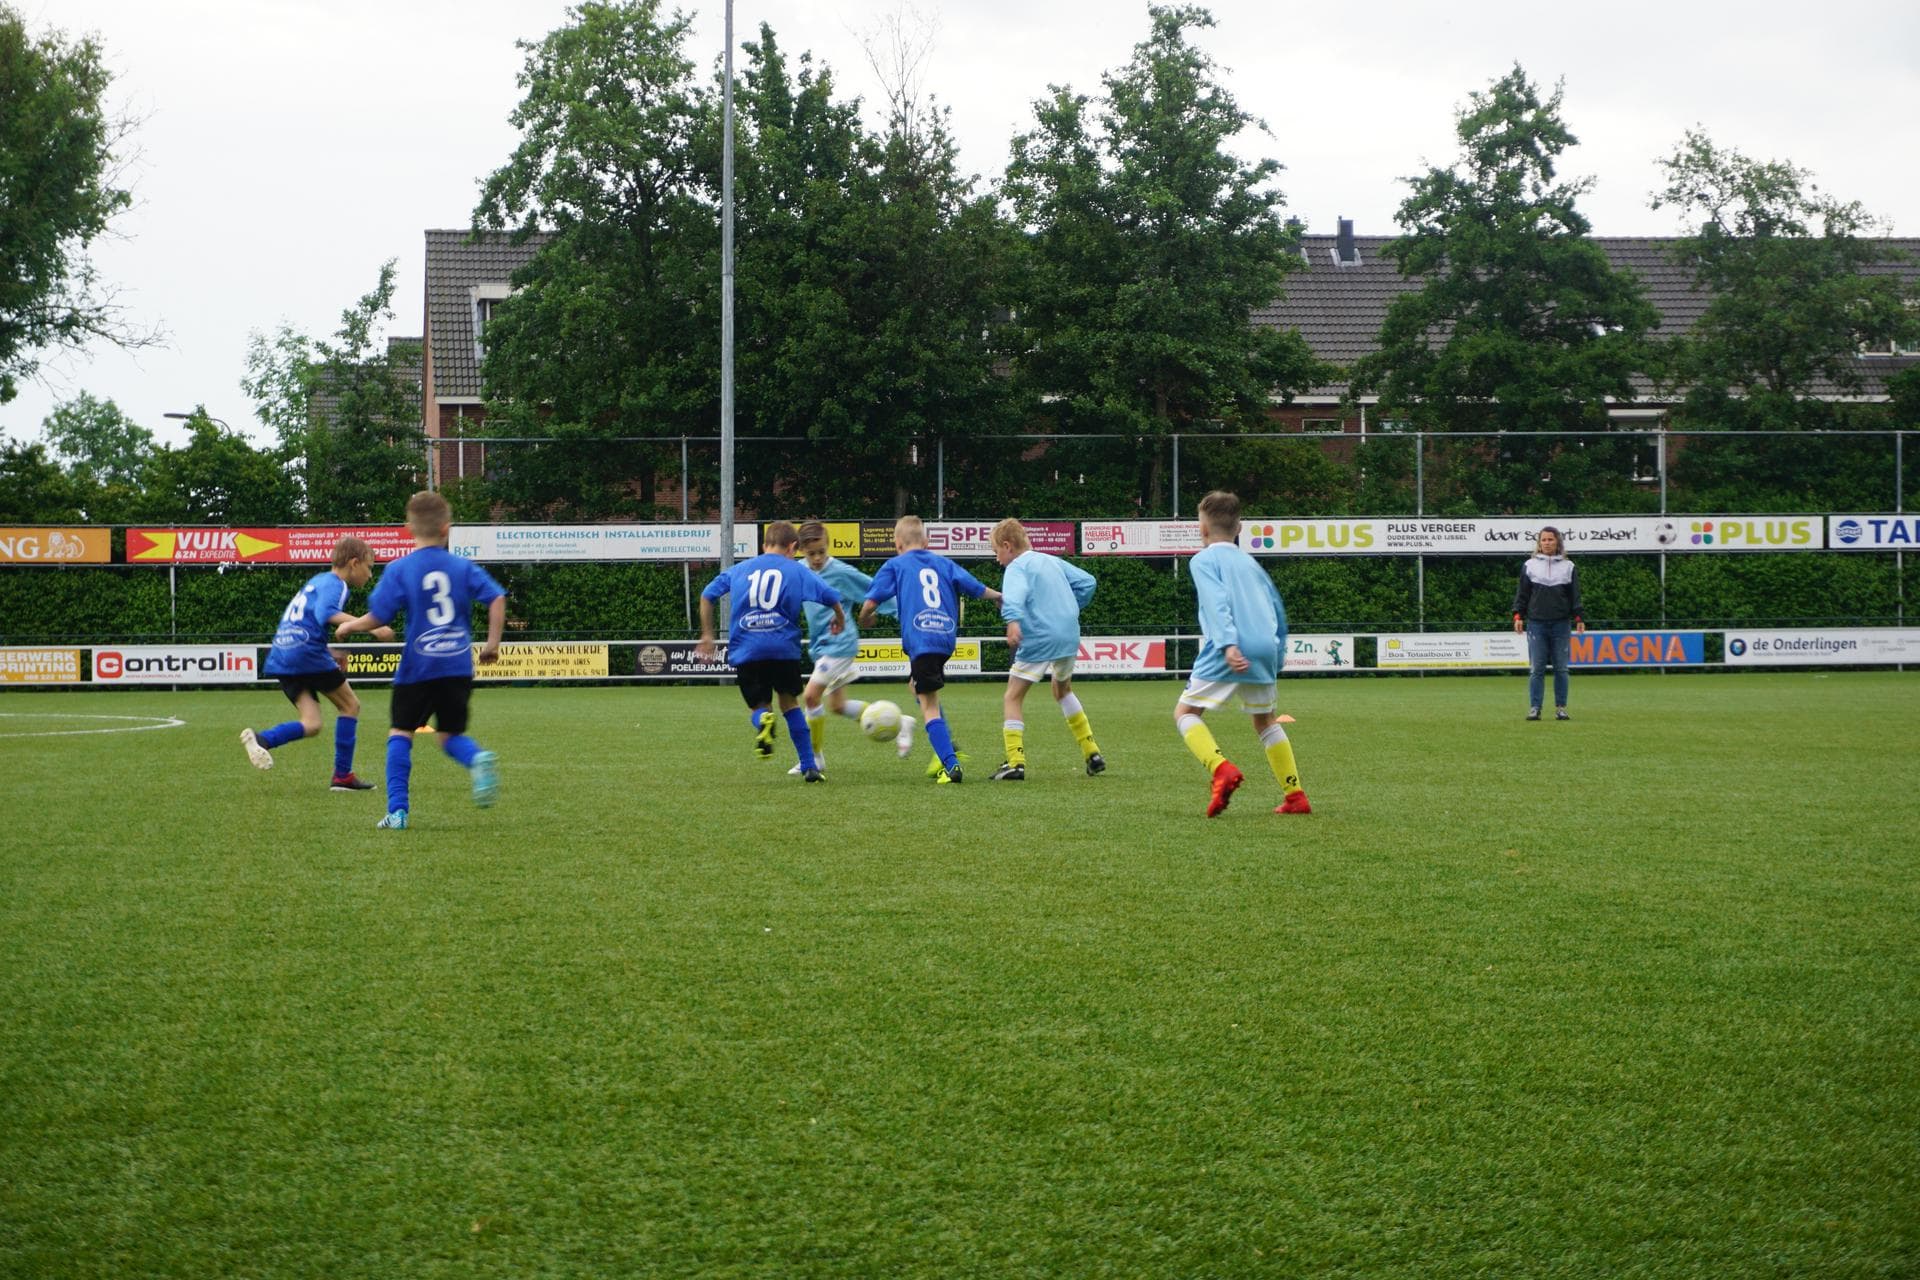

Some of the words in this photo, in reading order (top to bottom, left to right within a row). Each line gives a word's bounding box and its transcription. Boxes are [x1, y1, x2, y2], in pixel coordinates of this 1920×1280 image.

[496, 531, 599, 540] ELECTROTECHNISCH
[604, 529, 712, 539] INSTALLATIEBEDRIJF
[1388, 524, 1417, 533] PLUS
[1421, 523, 1476, 532] VERGEER
[1484, 528, 1520, 541] daar
[1579, 530, 1588, 540] u
[1590, 527, 1637, 541] zeker!
[1720, 521, 1811, 544] PLUS
[1867, 520, 1920, 543] TA
[177, 531, 239, 550] VUIK
[833, 538, 856, 548] b.v.
[1281, 524, 1374, 548] PLUS
[174, 551, 197, 559] &ZN
[199, 550, 236, 559] EXPEDITIE
[454, 545, 480, 557] B&T
[747, 568, 783, 611] 10
[919, 567, 941, 609] 8
[422, 570, 456, 627] 3
[1294, 640, 1318, 653] Zn.
[1569, 635, 1686, 662] MAGNA
[1752, 638, 1769, 650] de
[1773, 637, 1857, 652] Onderlingen
[347, 654, 373, 662] 0180
[0, 662, 77, 673] PRINTING
[347, 662, 401, 673] MYMOV
